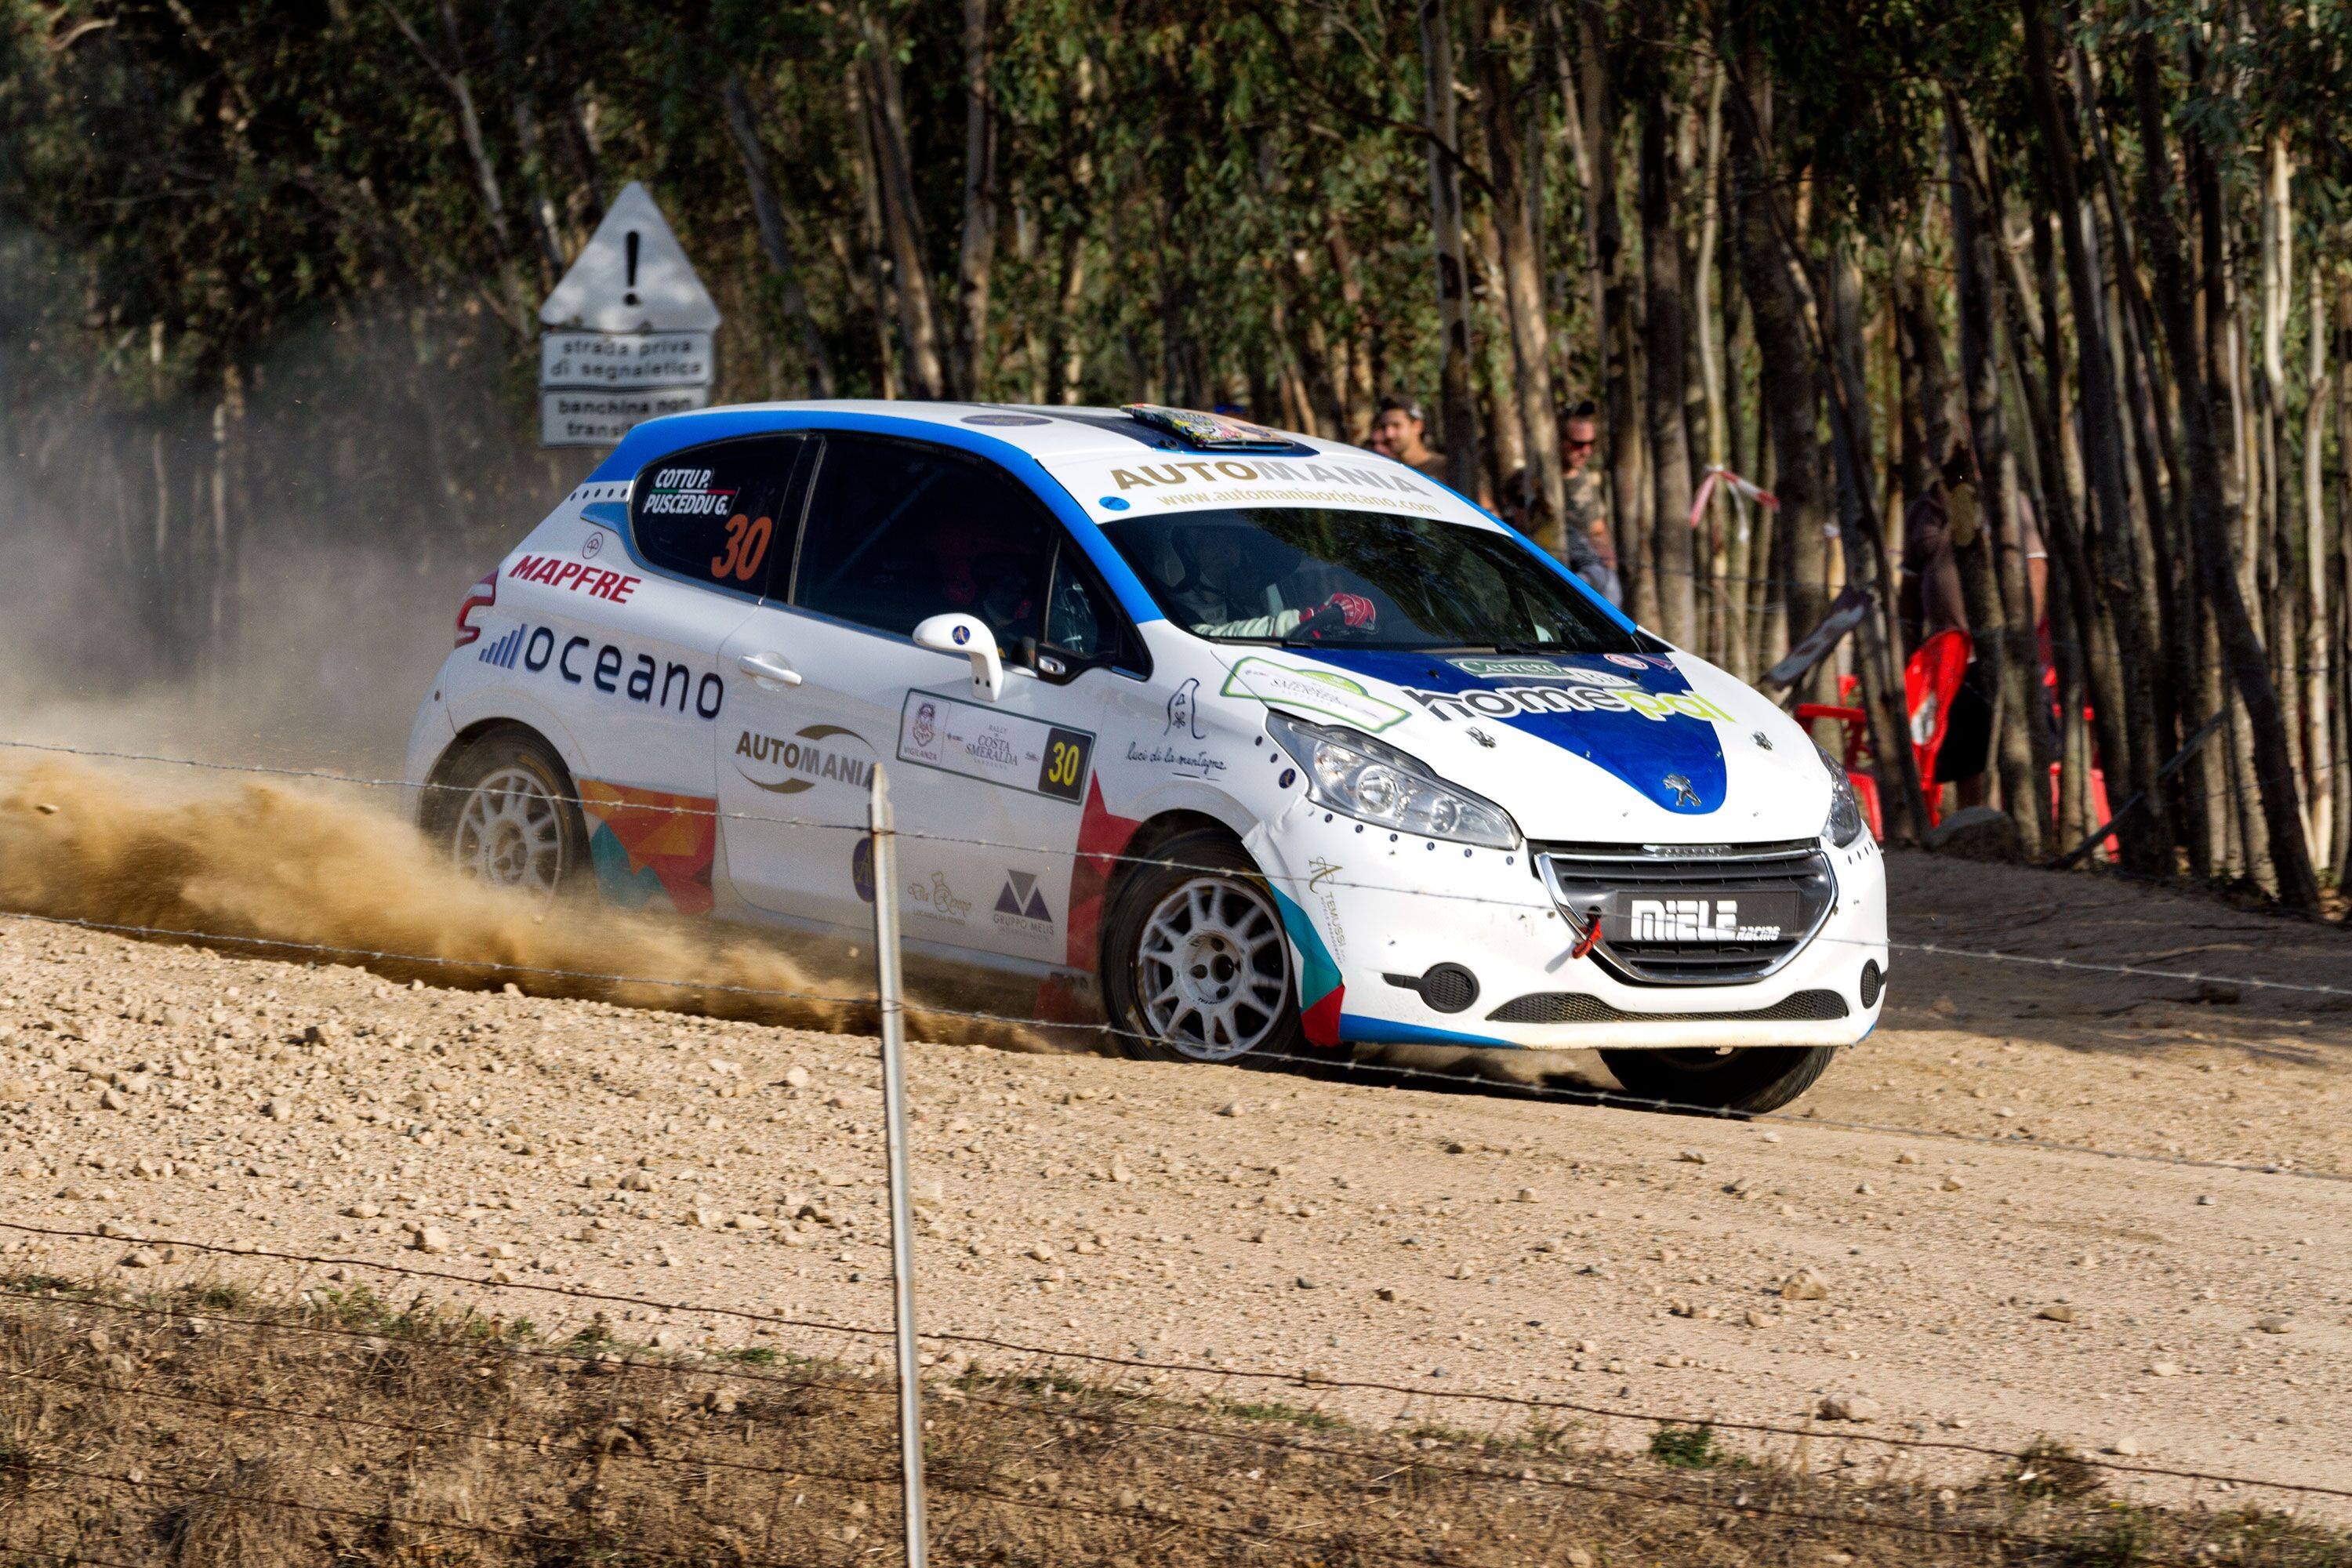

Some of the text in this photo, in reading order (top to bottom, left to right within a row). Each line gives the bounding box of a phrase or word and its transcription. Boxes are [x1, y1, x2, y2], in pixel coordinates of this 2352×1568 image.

[562, 339, 691, 358] strada priva
[550, 358, 702, 382] di segnaletica
[558, 397, 693, 416] banchina non
[655, 469, 712, 488] COTTU P.
[1109, 461, 1432, 497] AUTOMANIA
[643, 494, 729, 516] PUSCEDDU G.
[1156, 485, 1443, 515] www.automaniaoristano.com
[710, 514, 773, 581] 30
[508, 554, 641, 604] MAPFRE
[524, 626, 724, 720] oceano
[1401, 688, 1737, 723] homepal
[903, 746, 938, 761] VIGILANZA
[965, 742, 1018, 766] SMERALDA
[977, 734, 1011, 753] COSTA
[1047, 741, 1080, 787] 30
[993, 913, 1027, 929] GRUPPO
[1030, 921, 1054, 936] MELIS
[1325, 891, 1347, 947] TEMUSSI
